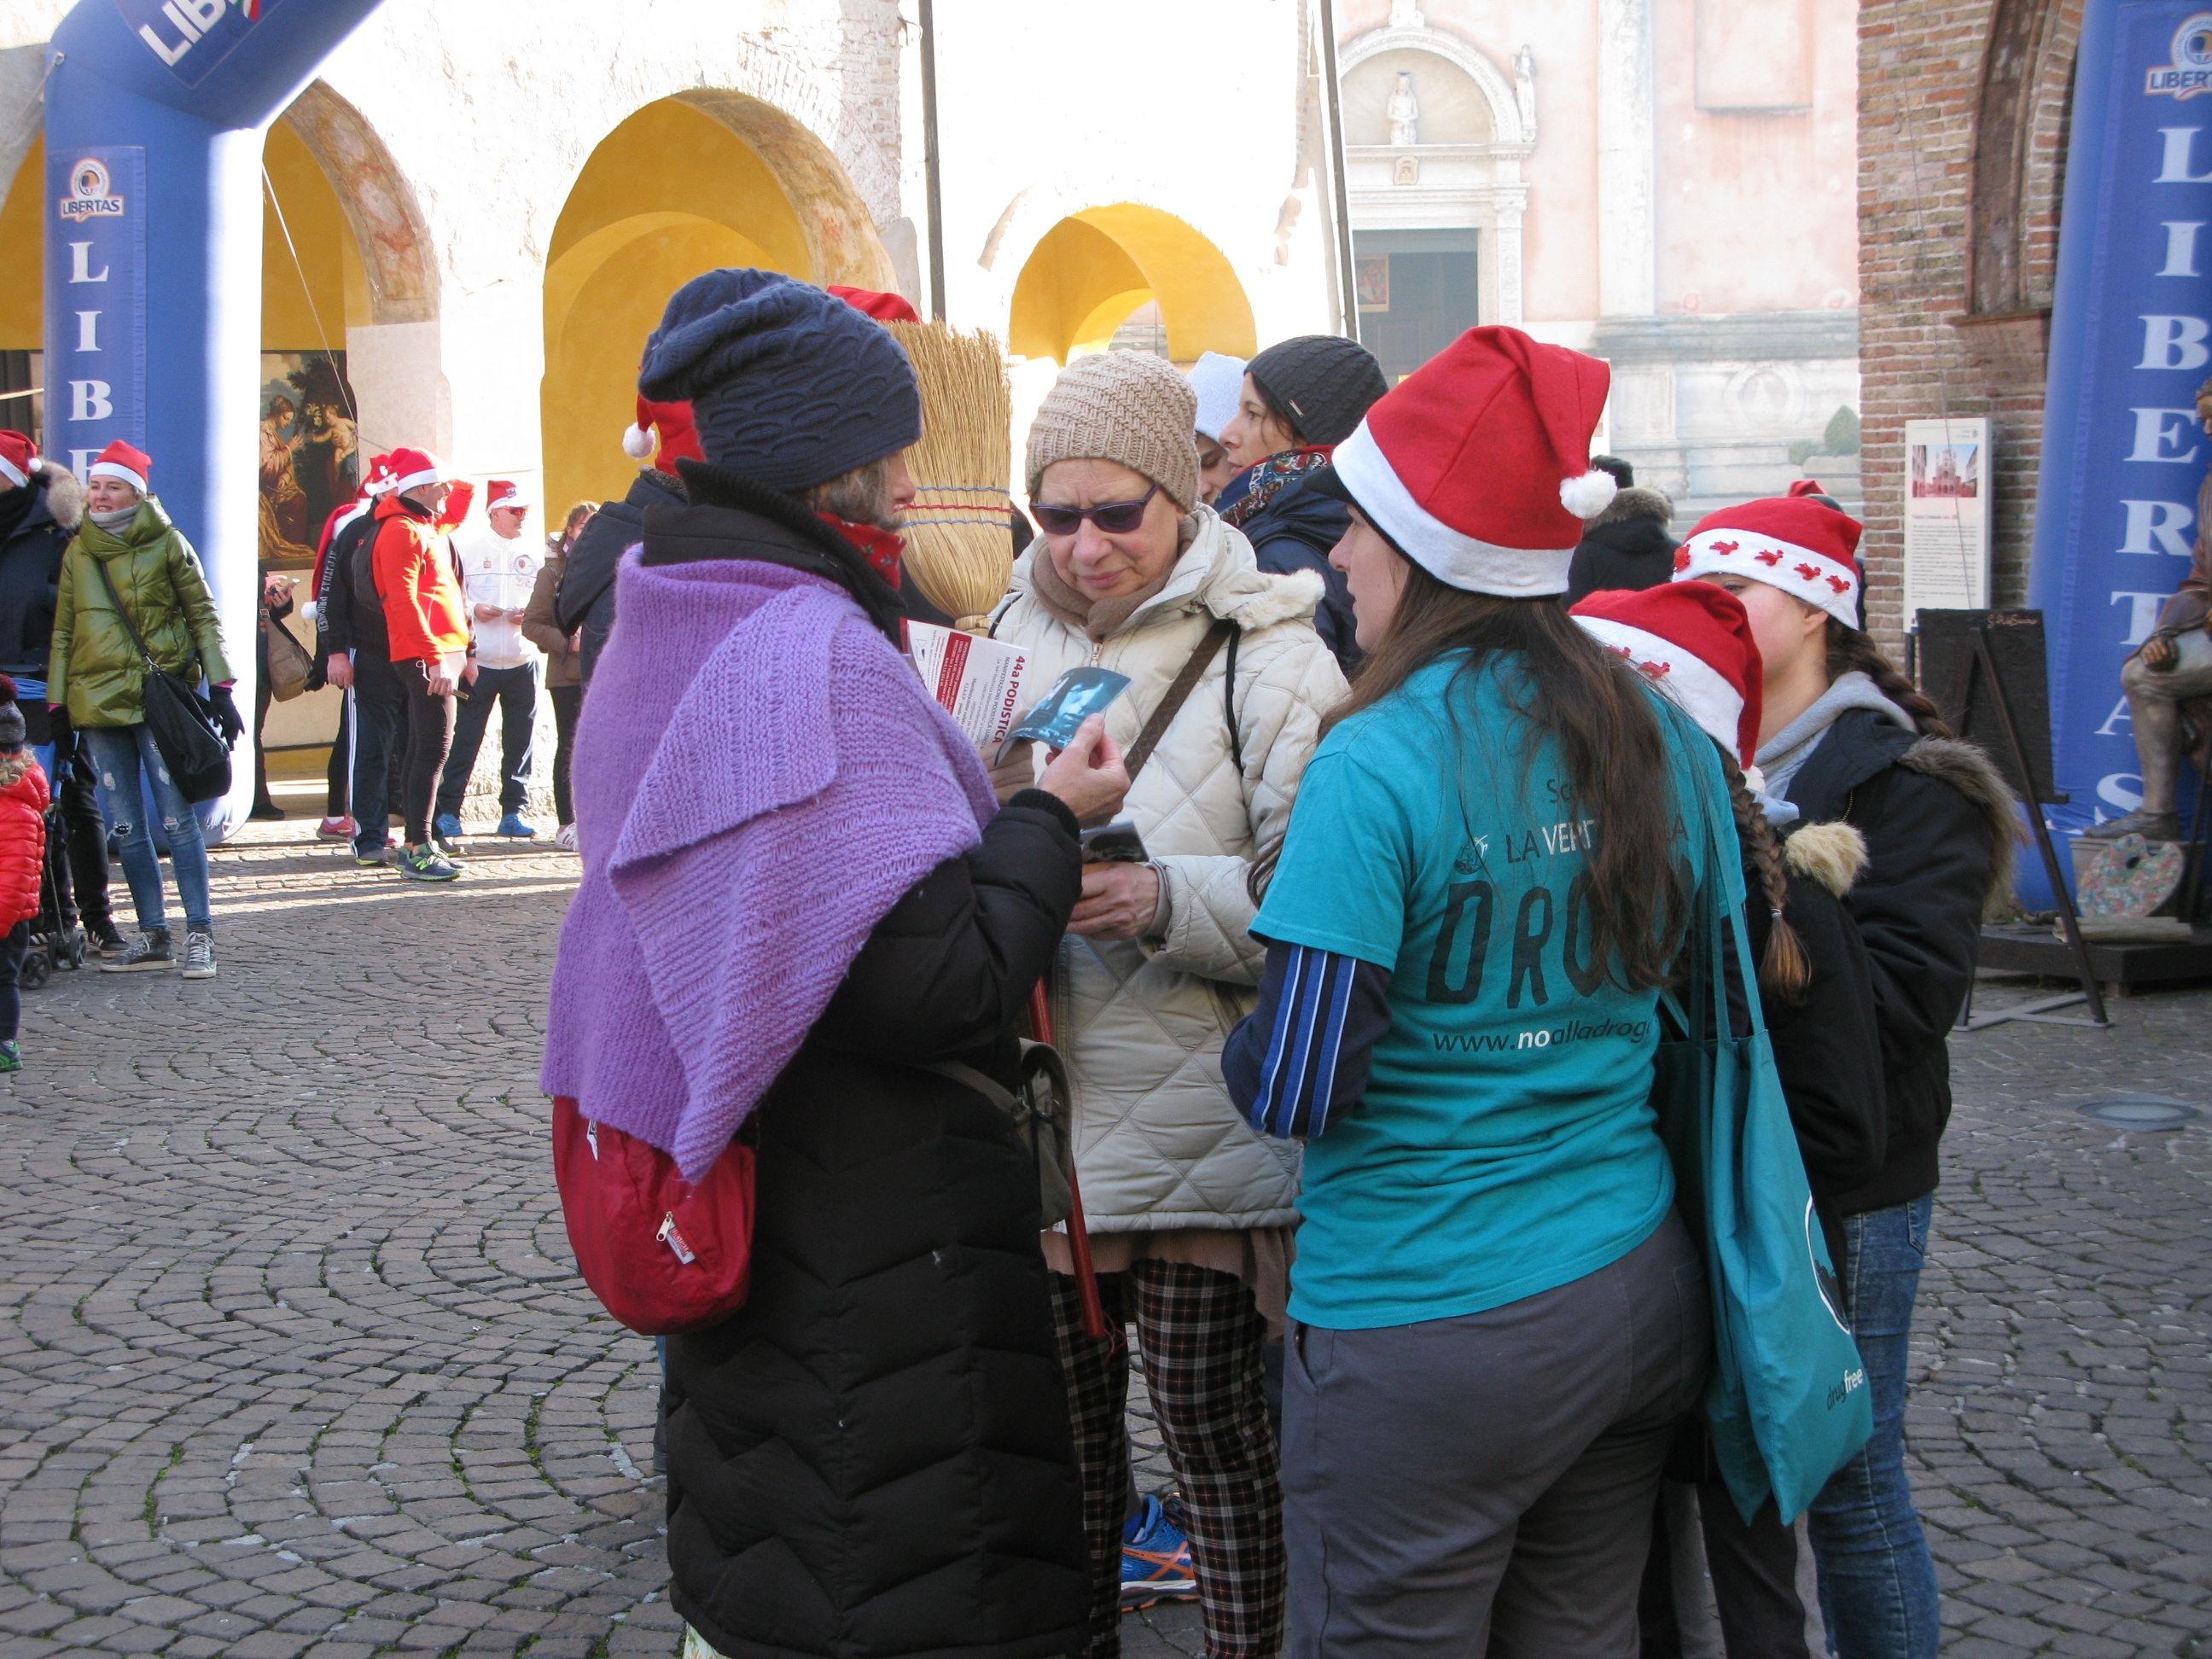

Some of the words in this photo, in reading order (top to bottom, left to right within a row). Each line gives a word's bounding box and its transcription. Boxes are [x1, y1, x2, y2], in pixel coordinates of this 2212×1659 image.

[138, 0, 238, 67] LIB
[2151, 71, 2212, 90] LIBER
[62, 199, 120, 215] LIBERTAS
[1011, 655, 1026, 678] 44a
[992, 680, 1020, 745] PODISTICA
[1505, 830, 1540, 864] LA
[1426, 856, 1695, 1009] DRO
[1433, 1018, 1650, 1052] www.noalladrog
